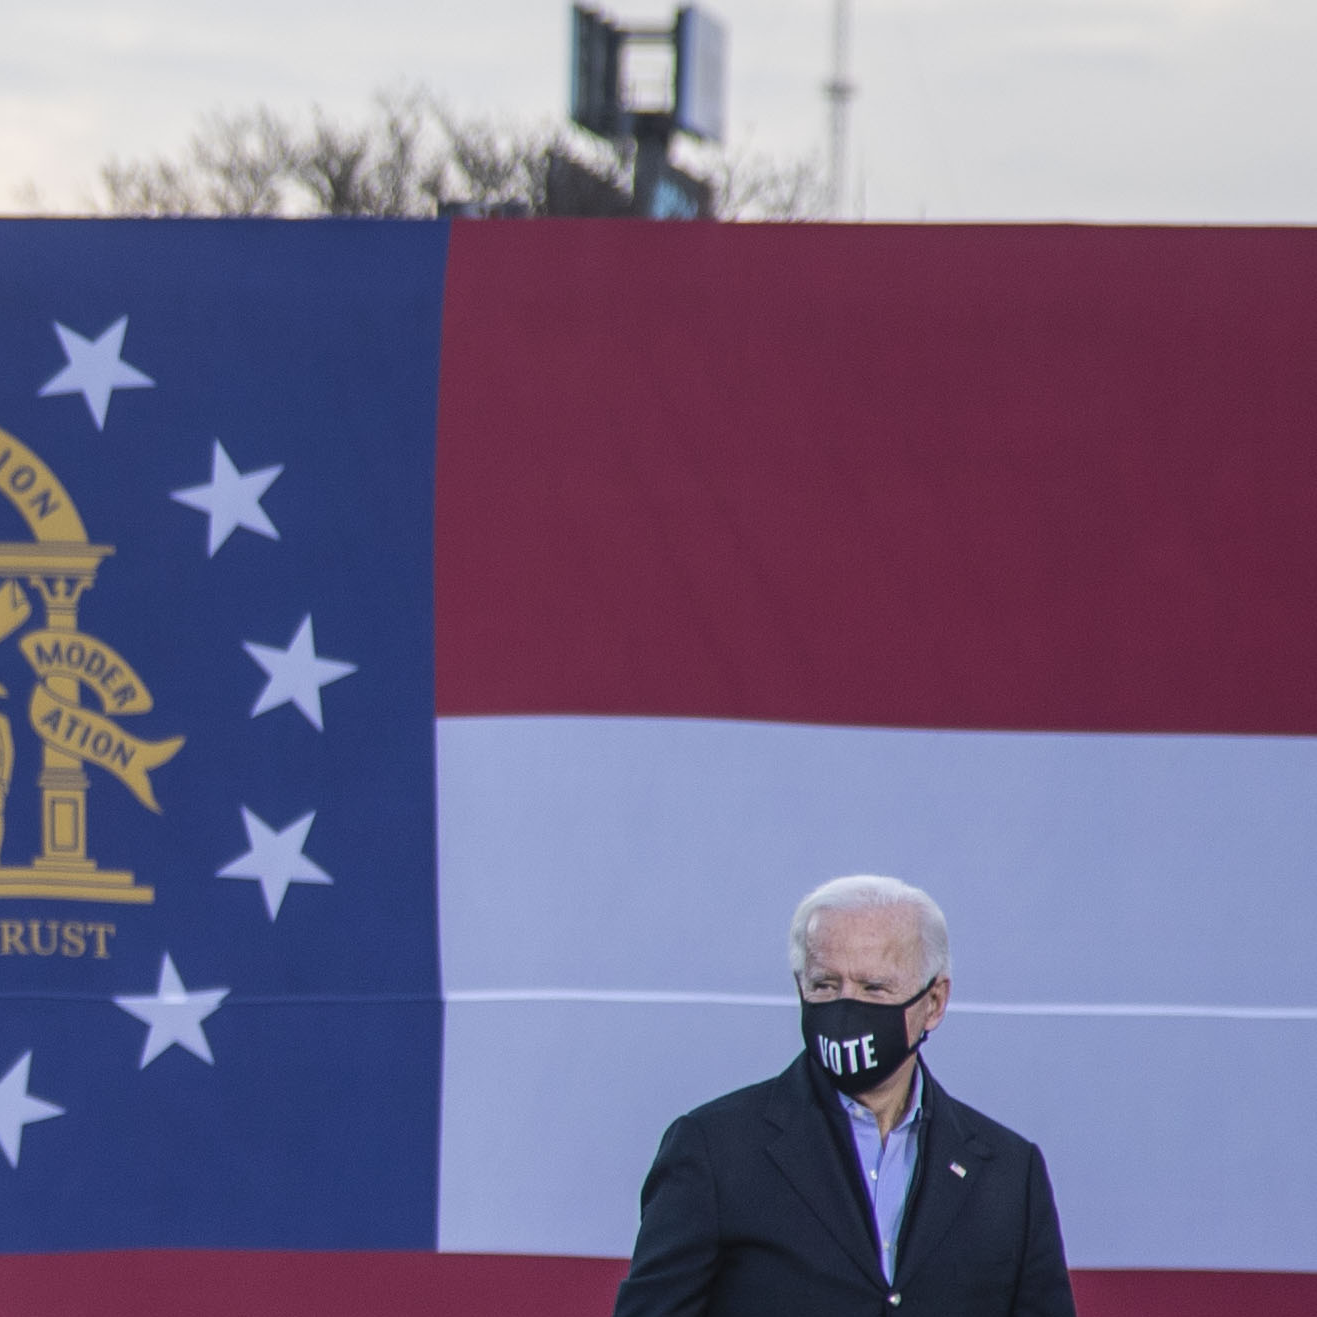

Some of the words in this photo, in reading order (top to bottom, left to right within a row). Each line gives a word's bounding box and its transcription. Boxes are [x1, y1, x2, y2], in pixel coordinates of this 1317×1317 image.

[34, 642, 140, 712] MODER
[44, 707, 138, 766] ATION
[817, 1033, 879, 1077] VOTE
